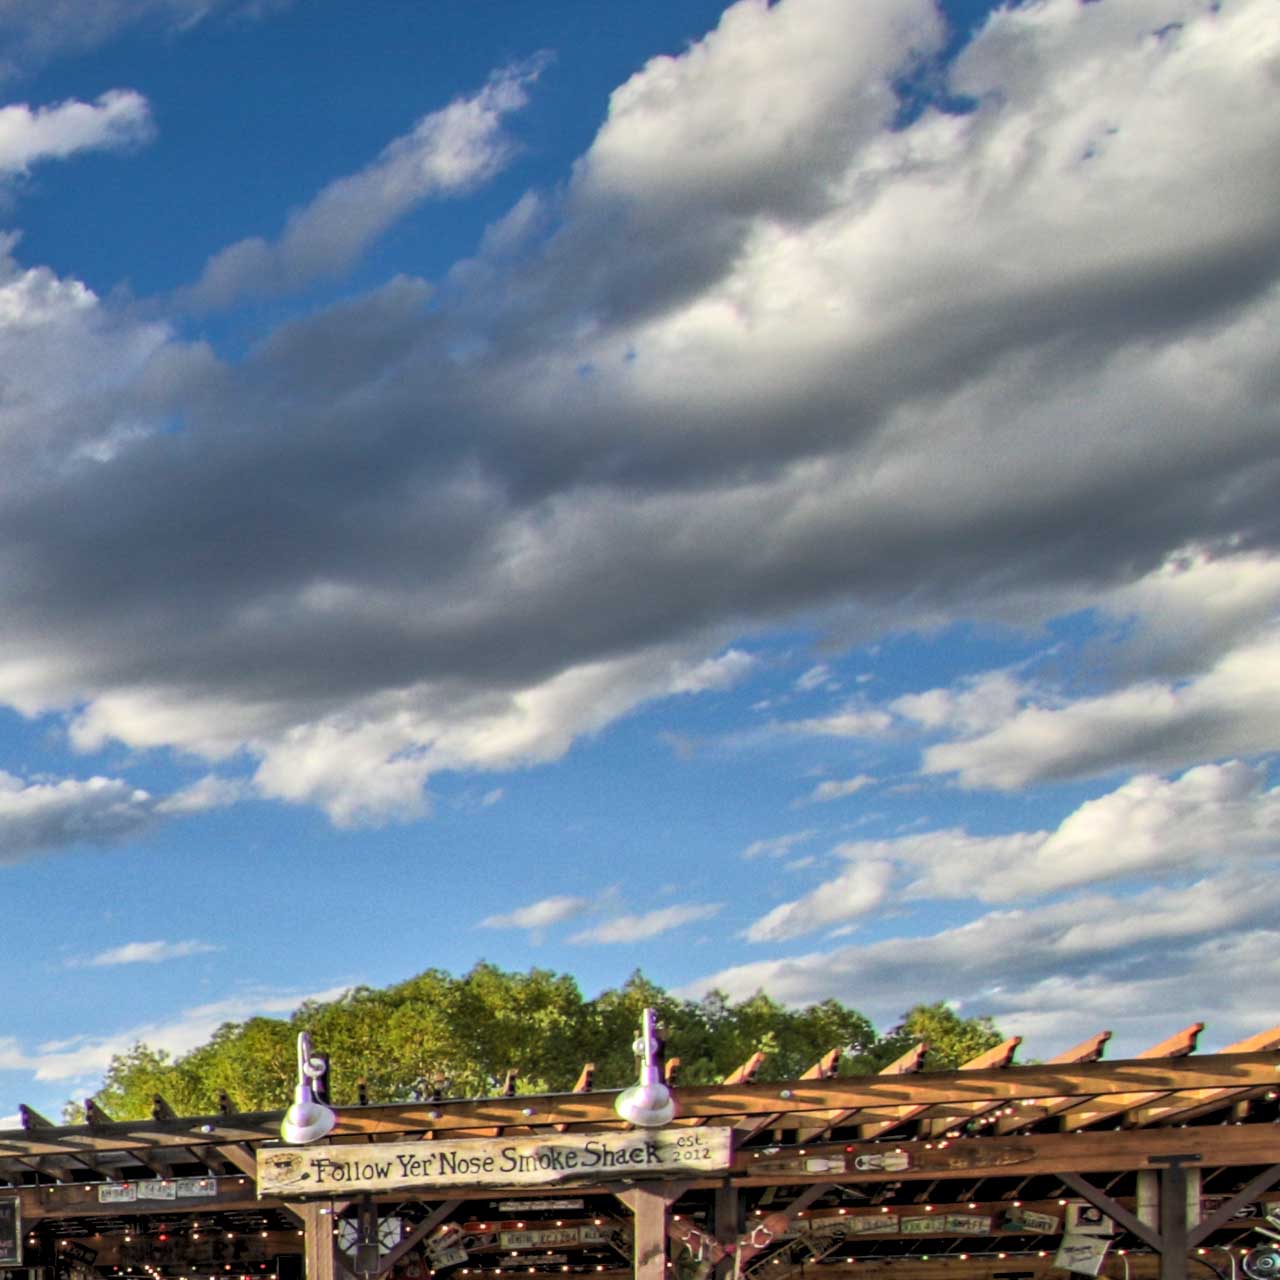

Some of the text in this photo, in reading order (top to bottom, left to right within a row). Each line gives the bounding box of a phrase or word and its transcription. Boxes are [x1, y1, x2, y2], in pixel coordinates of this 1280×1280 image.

[439, 1151, 495, 1175] Nose
[500, 1145, 578, 1173] Smoke
[581, 1140, 663, 1168] Shack
[672, 1148, 712, 1163] 2012
